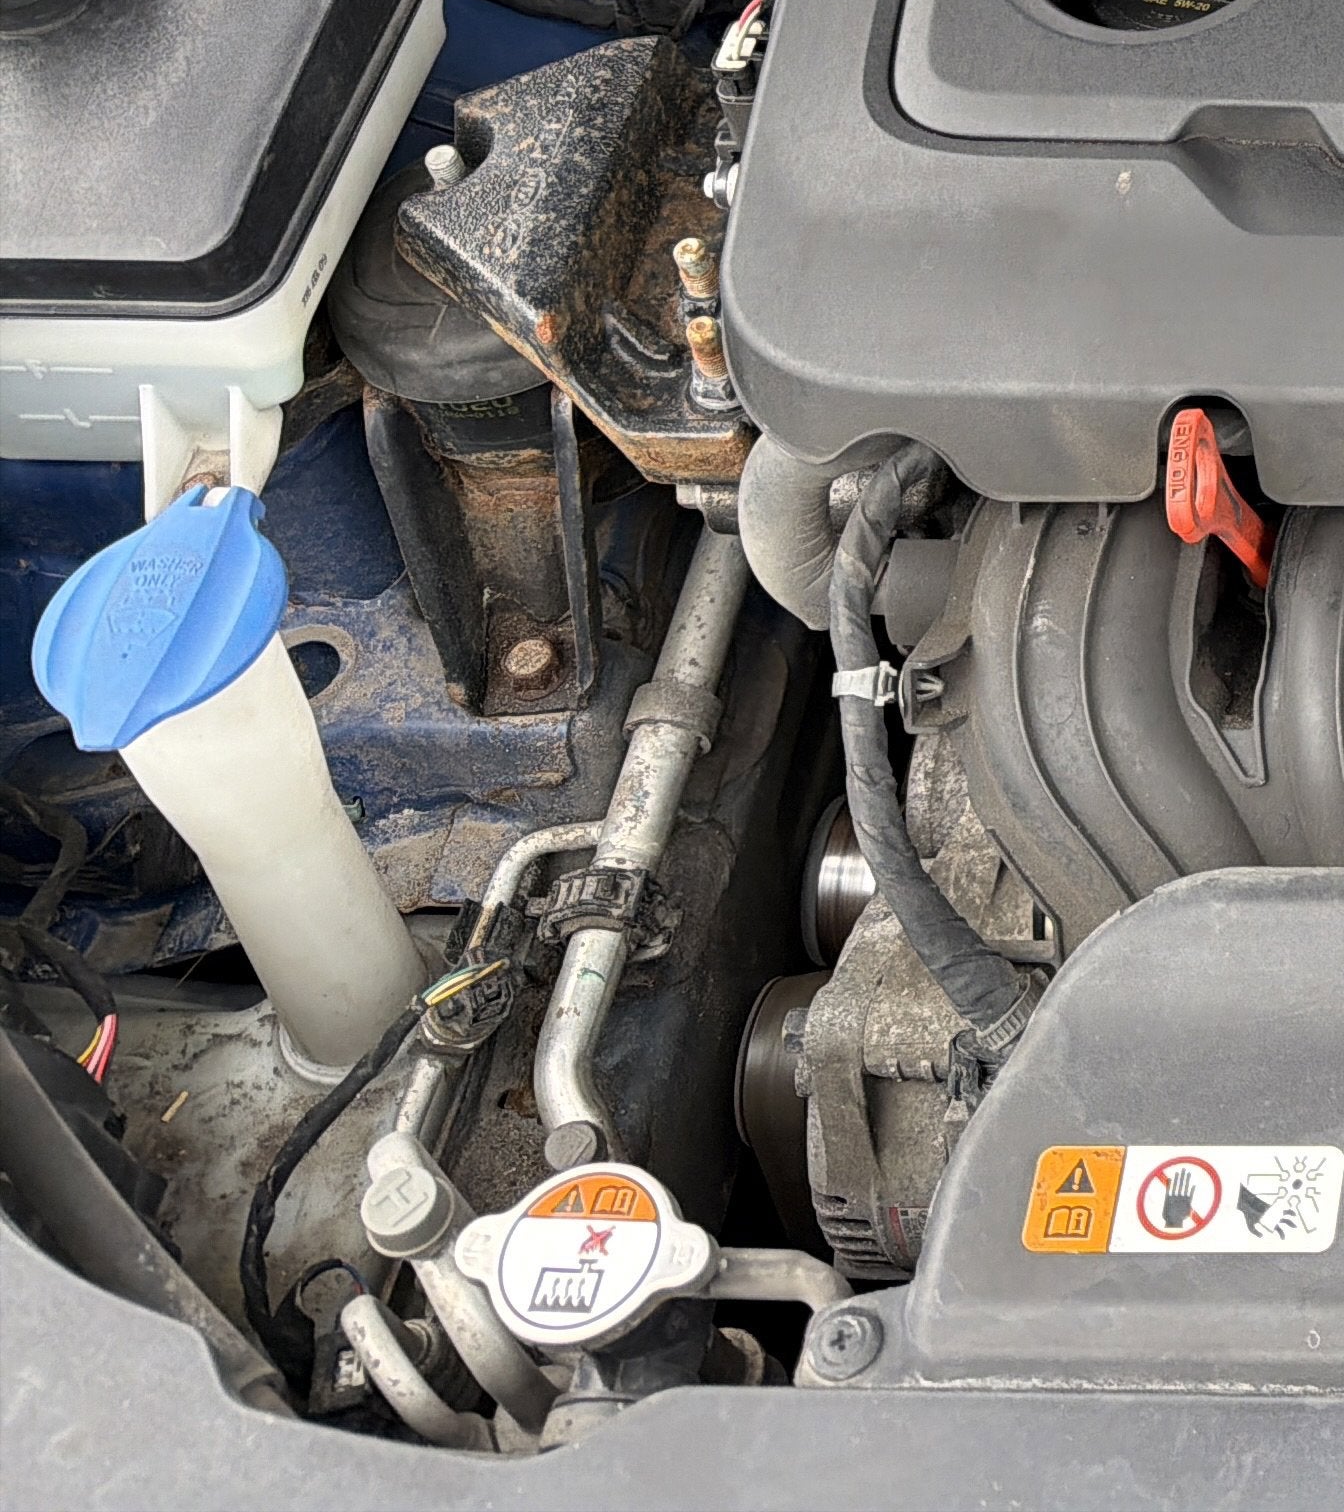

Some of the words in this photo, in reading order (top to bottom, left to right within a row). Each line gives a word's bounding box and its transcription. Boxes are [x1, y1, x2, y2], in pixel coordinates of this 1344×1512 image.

[1170, 423, 1192, 462] ENG
[1169, 467, 1187, 502] OIL
[130, 556, 203, 574] WASHER
[135, 573, 181, 587] ONLY
